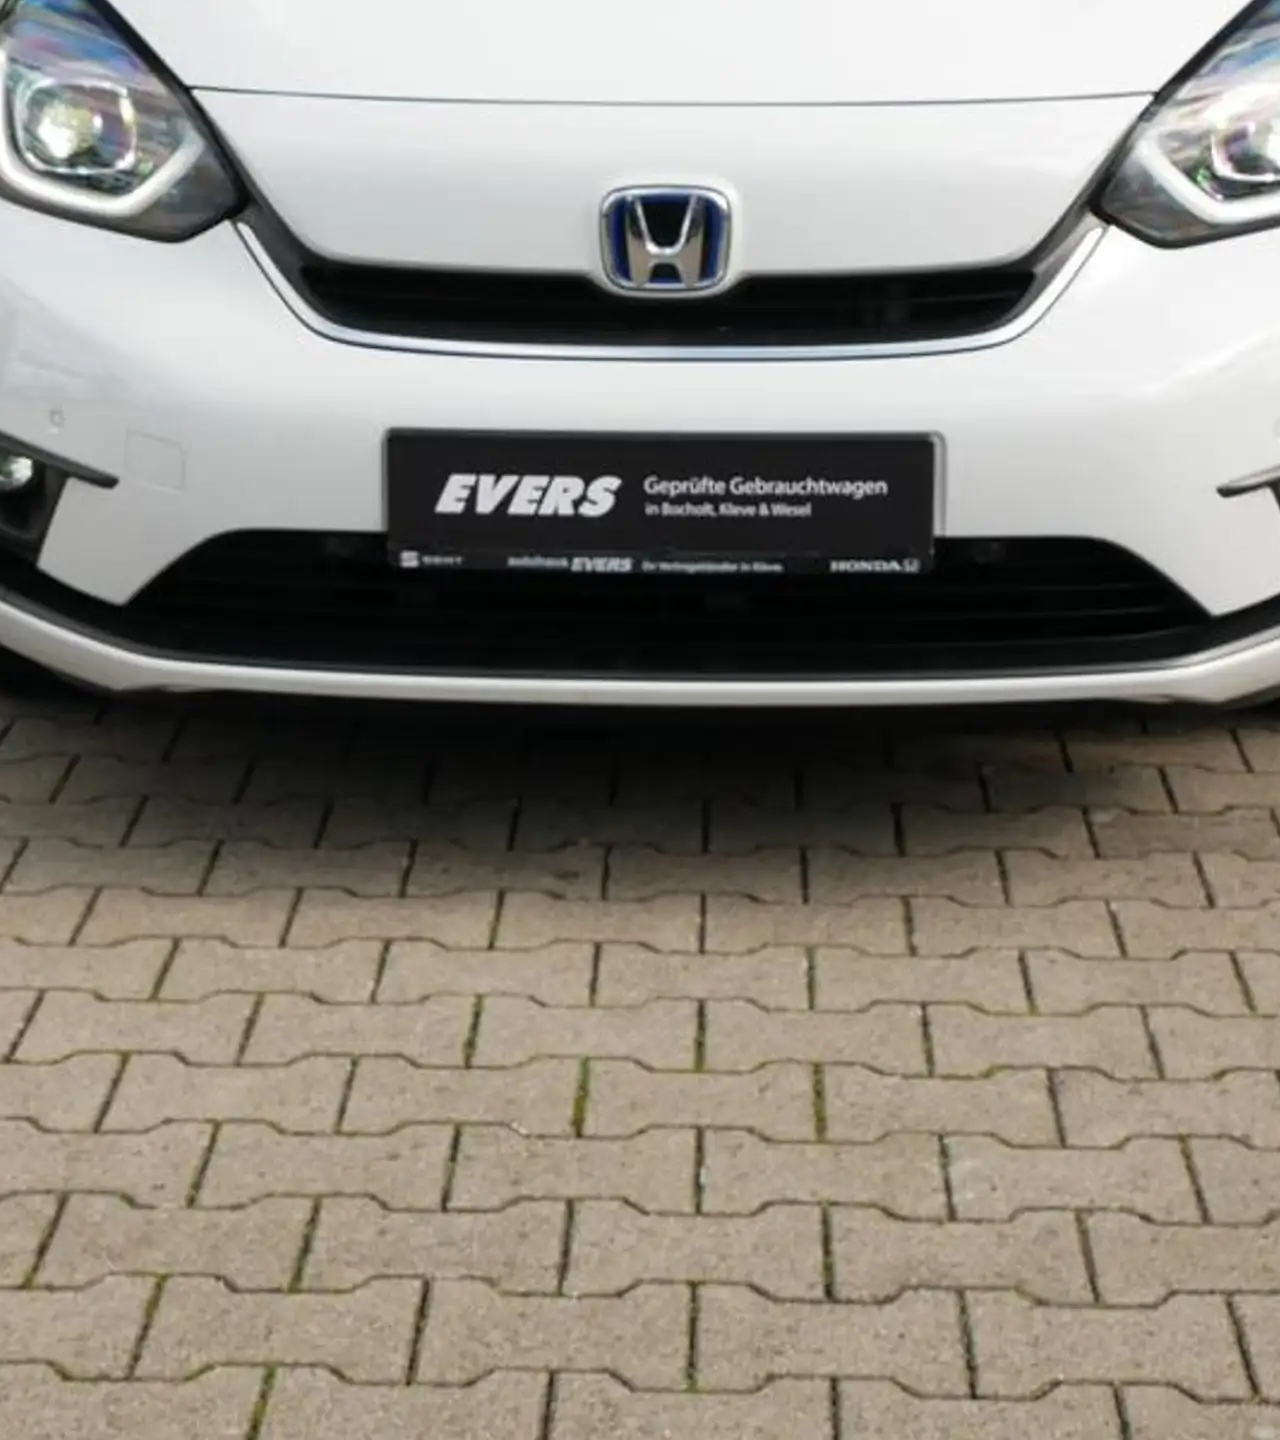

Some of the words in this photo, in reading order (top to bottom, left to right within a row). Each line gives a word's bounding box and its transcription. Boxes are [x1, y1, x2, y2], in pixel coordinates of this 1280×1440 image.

[434, 473, 622, 517] EVERS
[643, 474, 725, 497] Geprüfte
[729, 475, 888, 500] Gebrauchtwagen
[645, 502, 660, 516] in
[661, 502, 717, 518] Bocholt,
[719, 503, 756, 517] Kleve
[770, 503, 812, 518] Wesel
[570, 557, 632, 572] EVERS
